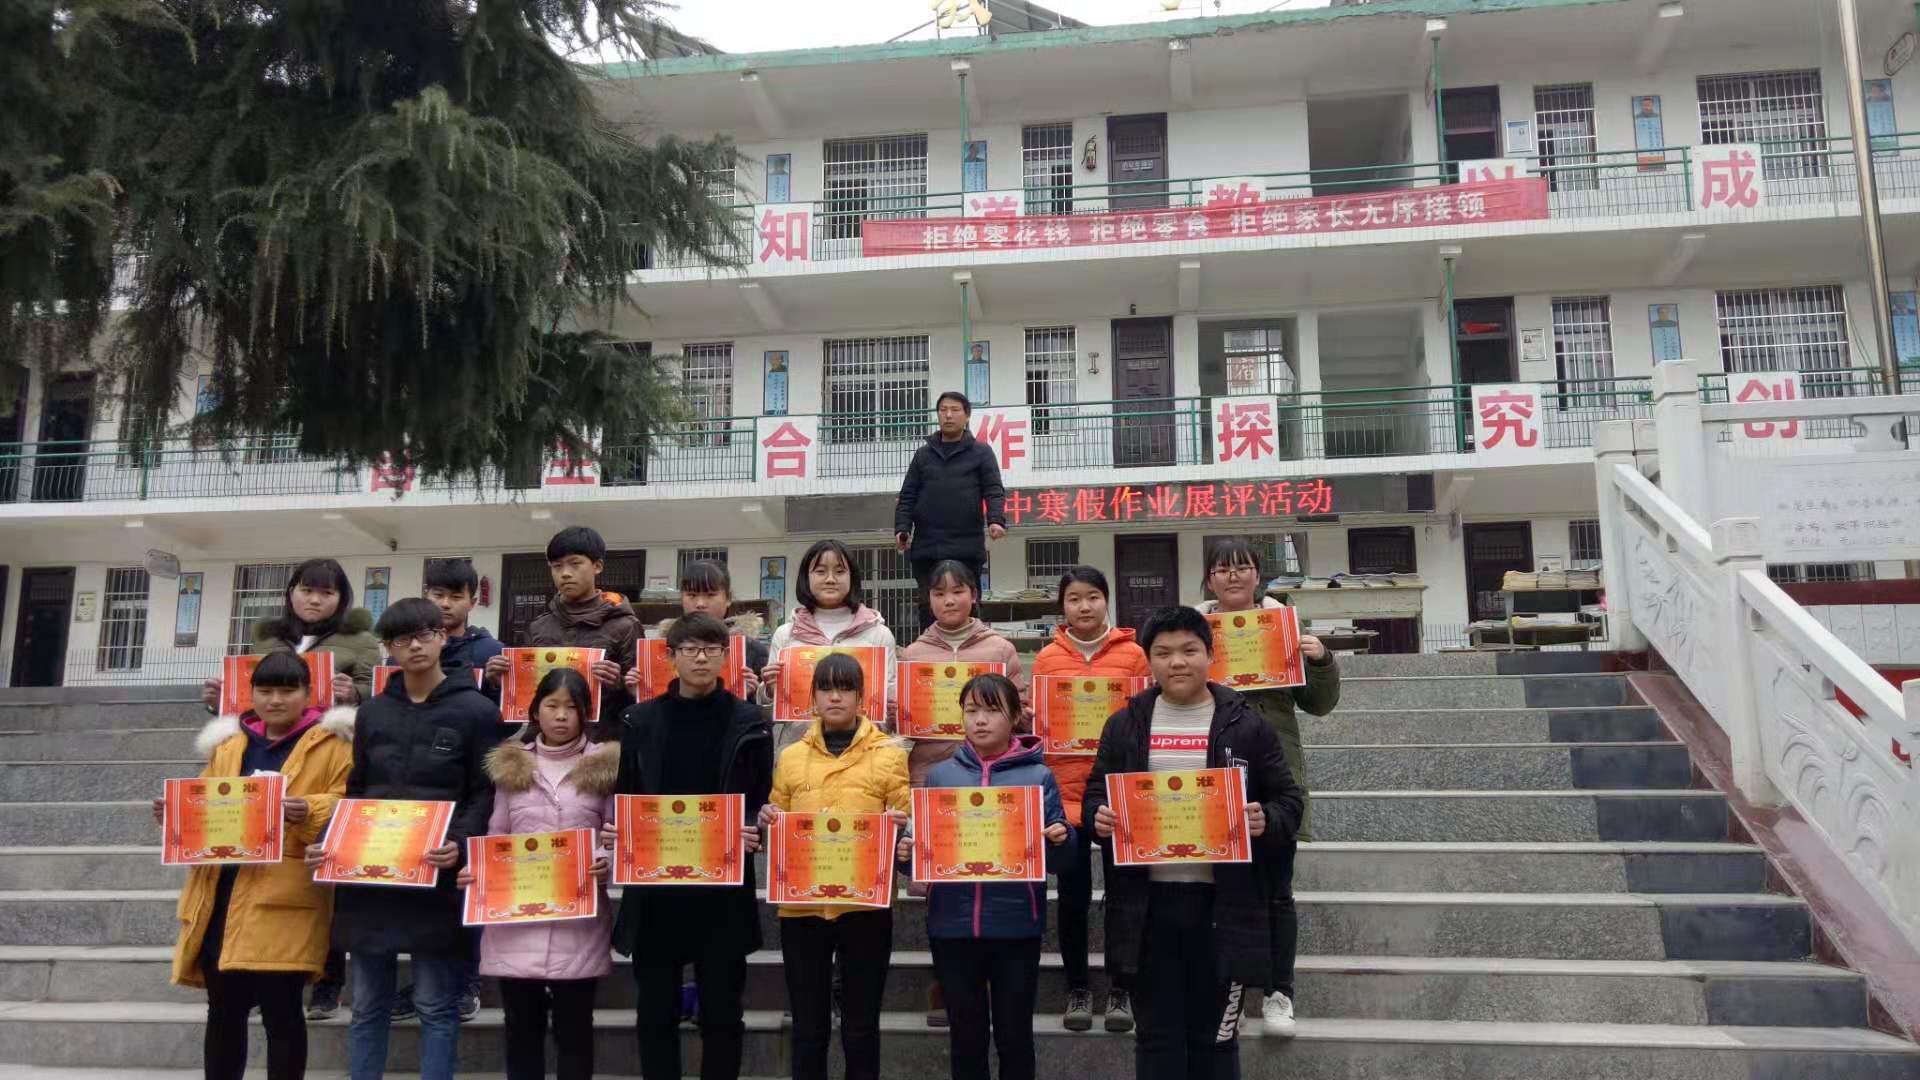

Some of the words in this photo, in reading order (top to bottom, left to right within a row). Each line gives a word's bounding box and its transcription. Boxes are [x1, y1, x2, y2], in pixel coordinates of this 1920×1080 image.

[760, 209, 808, 262] 知
[1701, 152, 1758, 208] 成
[923, 218, 1071, 250] 拒绝零花钱
[1089, 211, 1209, 242] 拒绝零食
[1230, 191, 1486, 234] 拒绝家长无序接领
[762, 421, 812, 479] 合
[976, 413, 1027, 470] 作
[1217, 403, 1274, 462] 探
[1479, 390, 1538, 451] 究
[1003, 479, 1333, 524] 中寒假作业展评活动
